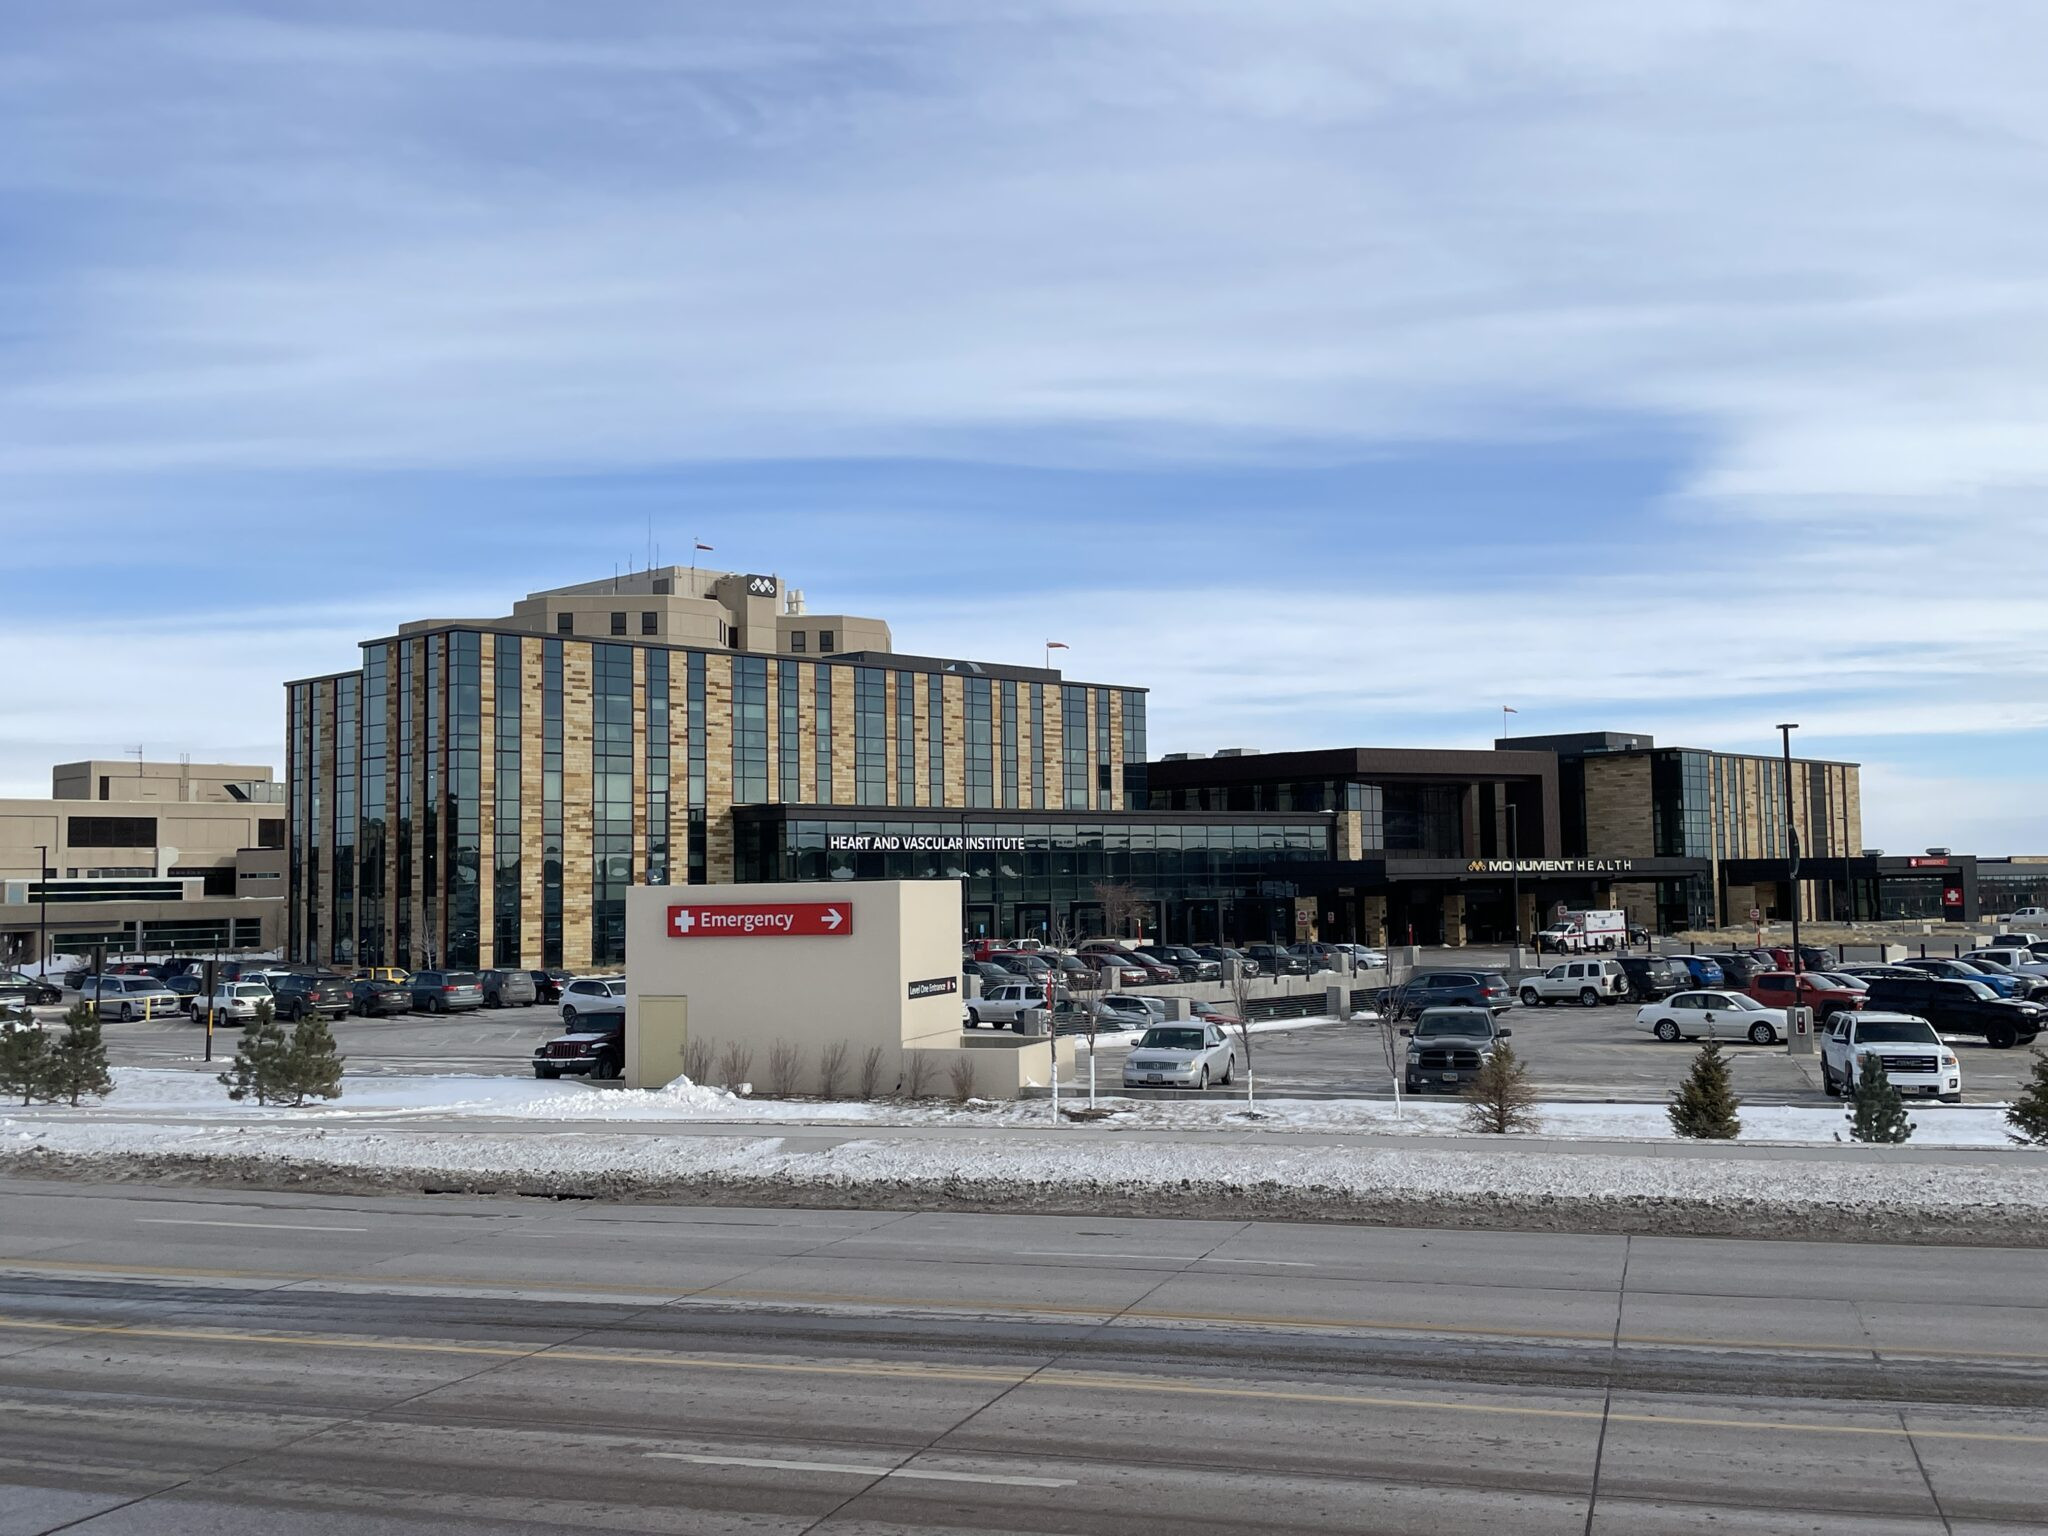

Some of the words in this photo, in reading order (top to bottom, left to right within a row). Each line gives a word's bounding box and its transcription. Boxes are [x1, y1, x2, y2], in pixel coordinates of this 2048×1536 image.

[830, 836, 872, 850] HEART
[873, 836, 900, 850] AND
[902, 836, 963, 850] VASCULAR
[965, 837, 1025, 850] INSTITUTE
[1488, 860, 1574, 872] MONUMENT
[1577, 860, 1632, 871] HEALTH
[700, 912, 794, 932] Emergency
[909, 985, 920, 995] Level
[920, 984, 929, 993] One
[929, 982, 946, 992] Entrance
